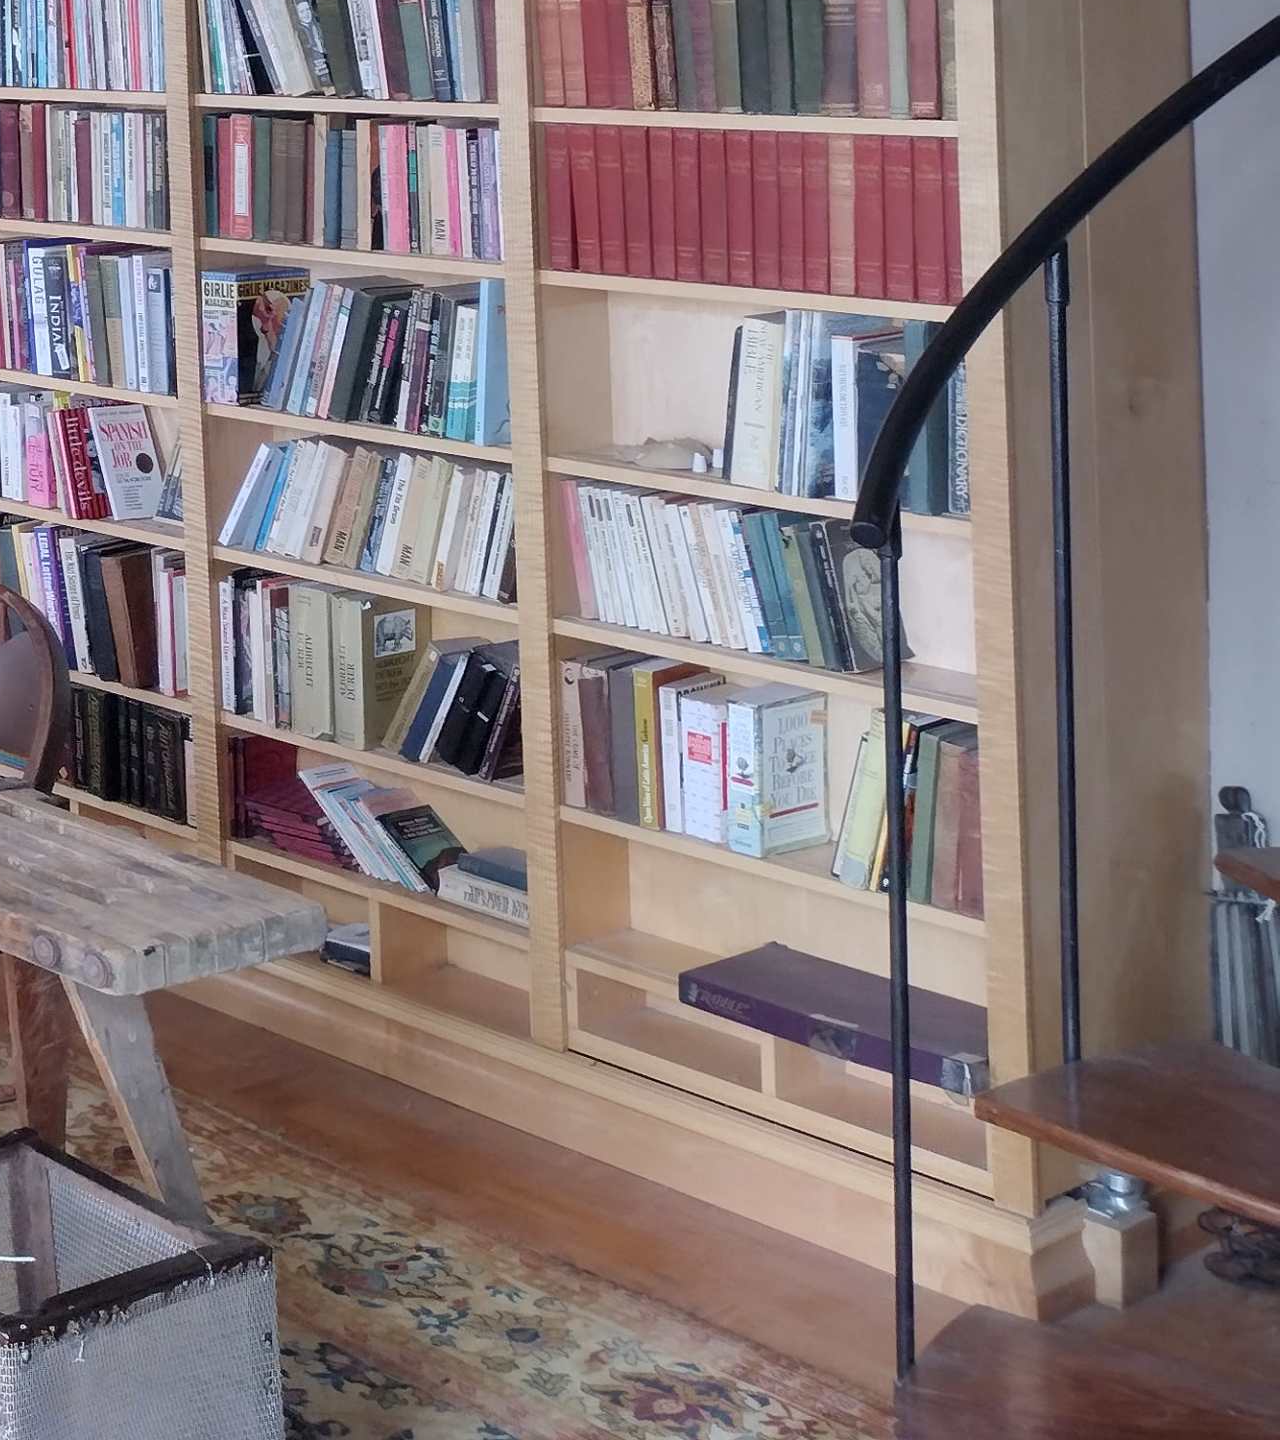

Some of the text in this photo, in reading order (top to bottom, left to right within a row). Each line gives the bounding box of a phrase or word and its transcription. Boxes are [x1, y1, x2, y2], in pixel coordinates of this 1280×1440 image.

[435, 219, 444, 239] MAN
[31, 255, 45, 304] GULAG
[237, 279, 310, 298] GIRLIE MAGAZINES
[203, 282, 235, 300] GIRLIE
[203, 298, 235, 309] MAGAZINES
[743, 329, 756, 369] BIBLE
[98, 421, 148, 442] SPANISH
[64, 416, 93, 510] little devils
[111, 449, 133, 468] JOB
[956, 416, 967, 496] DICTIONARY
[396, 478, 405, 490] The
[36, 532, 49, 559] LEGAL
[332, 530, 347, 551] MAN
[398, 544, 413, 565] MAN
[772, 771, 815, 790] BEFORE
[796, 785, 817, 803] DIE
